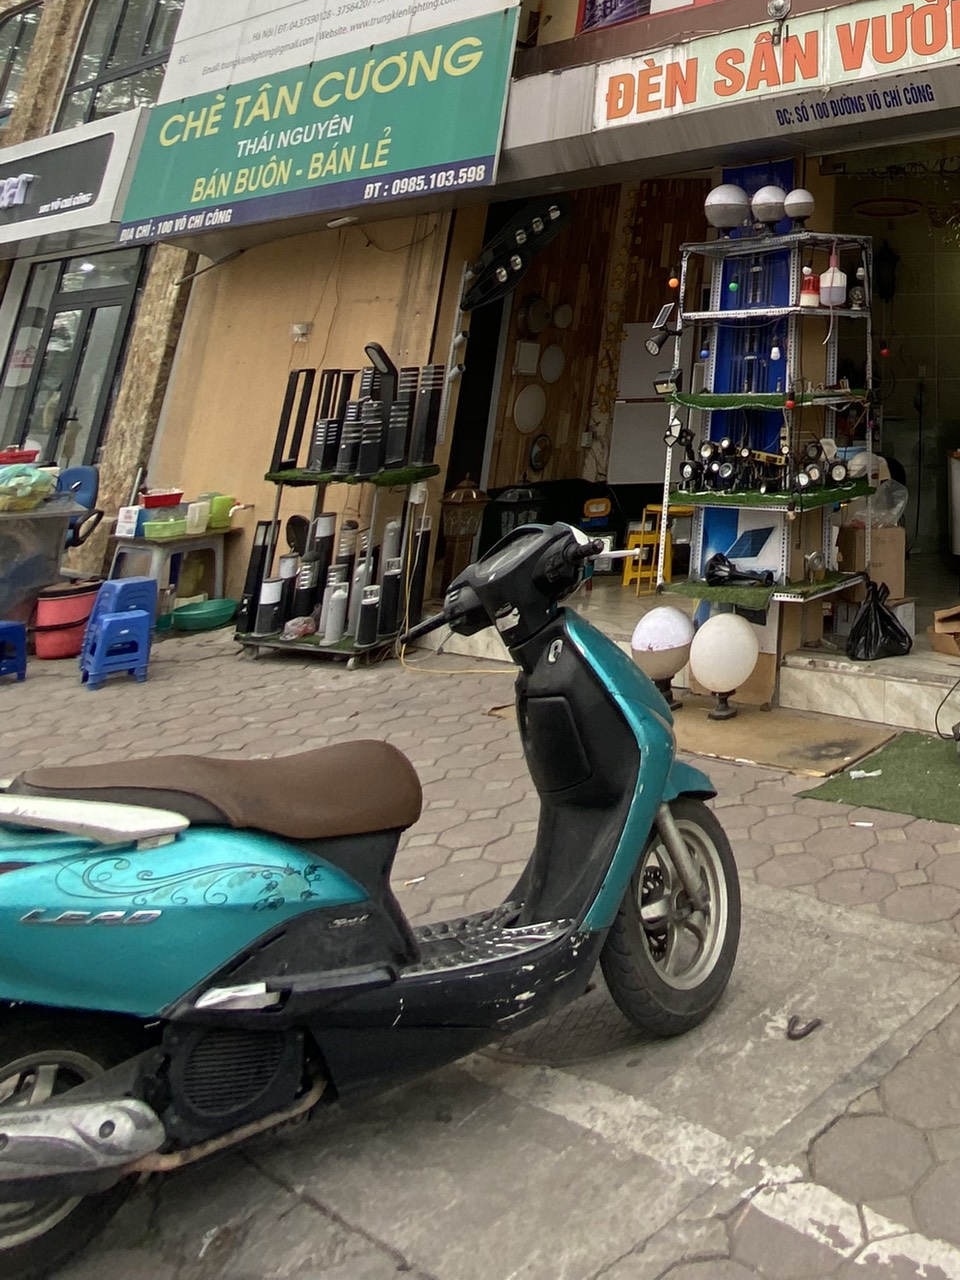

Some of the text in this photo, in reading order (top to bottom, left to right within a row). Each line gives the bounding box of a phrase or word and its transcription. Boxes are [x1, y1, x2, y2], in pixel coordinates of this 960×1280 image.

[158, 36, 485, 148] CHÈ TÂN CƯƠNG
[606, 58, 698, 121] ĐÈN
[713, 30, 818, 98] SÂN
[795, 82, 934, 123] SỐ 100 ĐƯỜNG CHÍ CÔNG
[236, 115, 354, 158] THÁI NGUYÊN
[191, 126, 392, 204] BÁN BUÔN BÁN LẺ
[391, 165, 485, 196] 0985.103.598
[19, 909, 163, 926] LEAD
